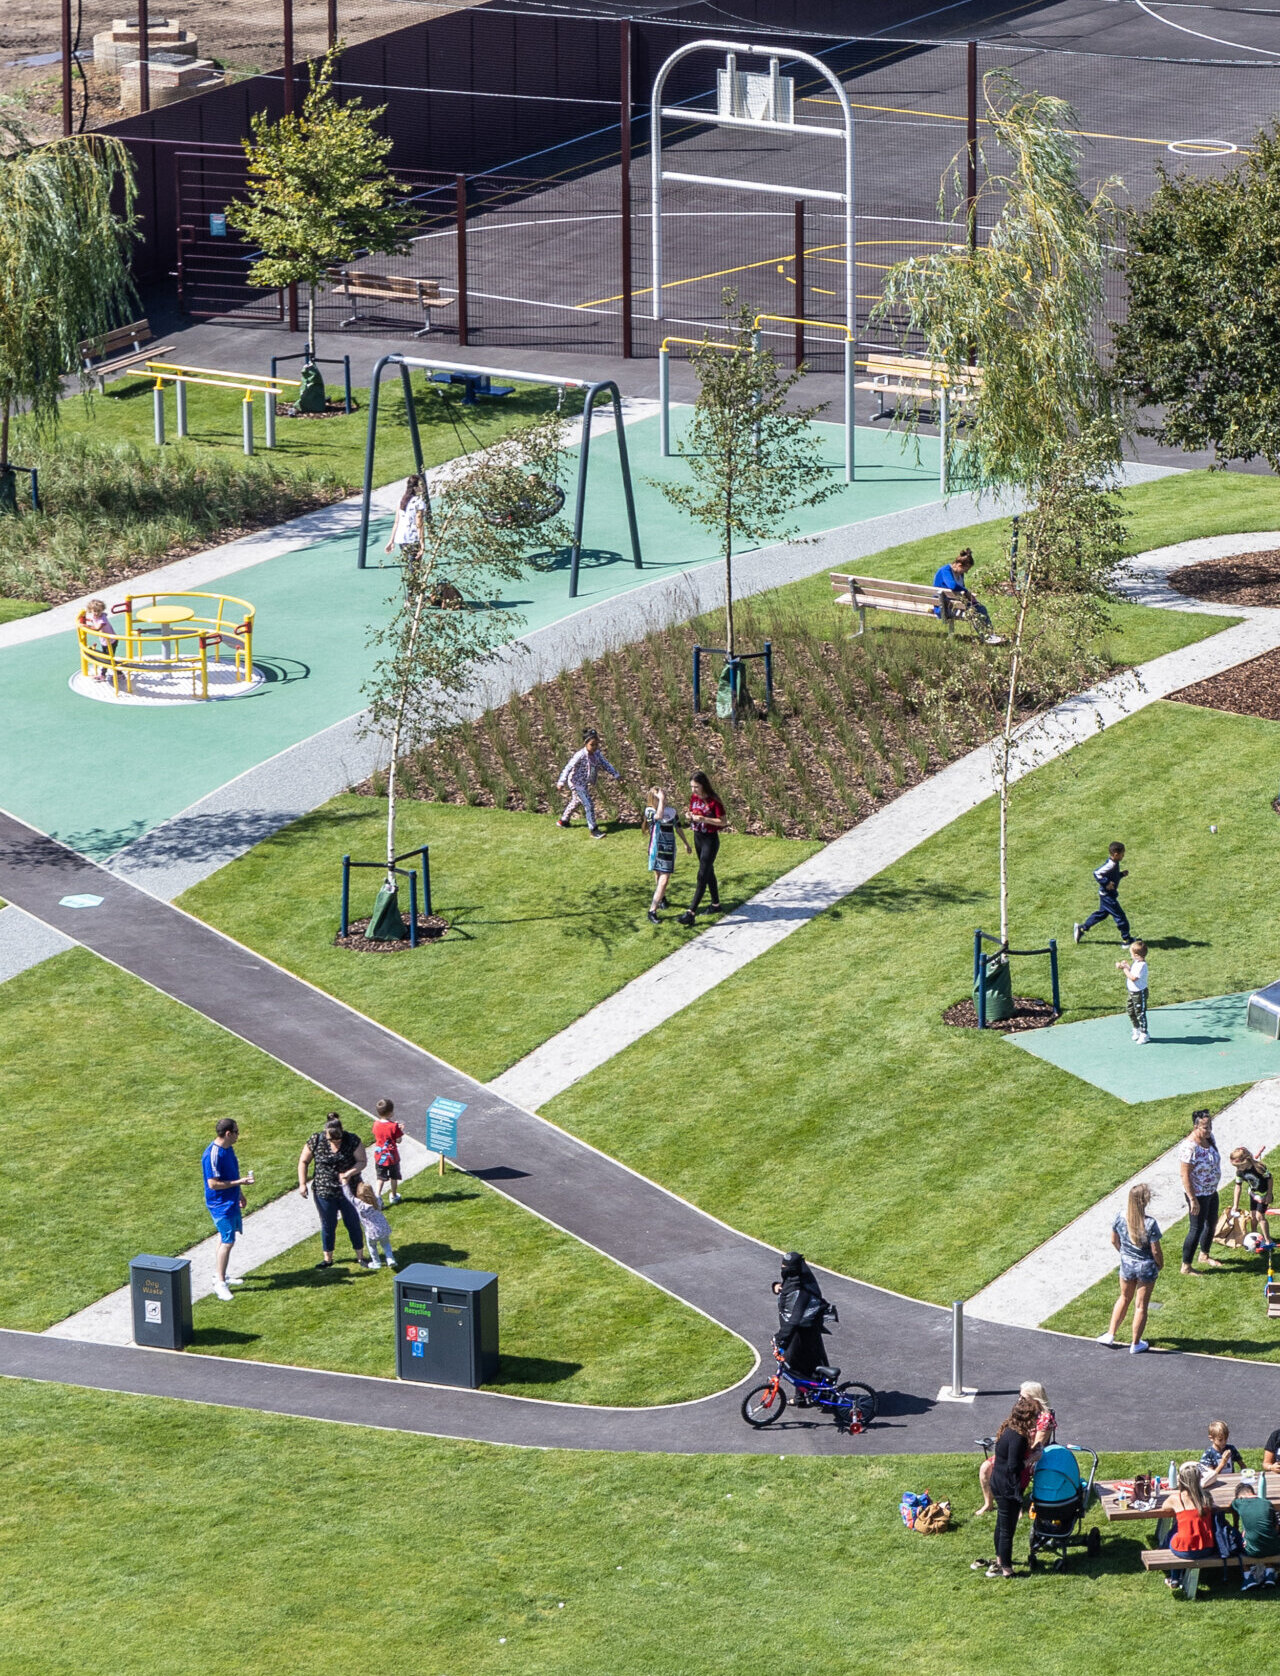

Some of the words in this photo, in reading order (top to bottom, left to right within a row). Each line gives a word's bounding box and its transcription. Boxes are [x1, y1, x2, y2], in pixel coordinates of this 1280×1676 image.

[142, 1287, 164, 1295] Waste
[408, 1301, 427, 1310] Mixed
[404, 1306, 432, 1317] Recycling
